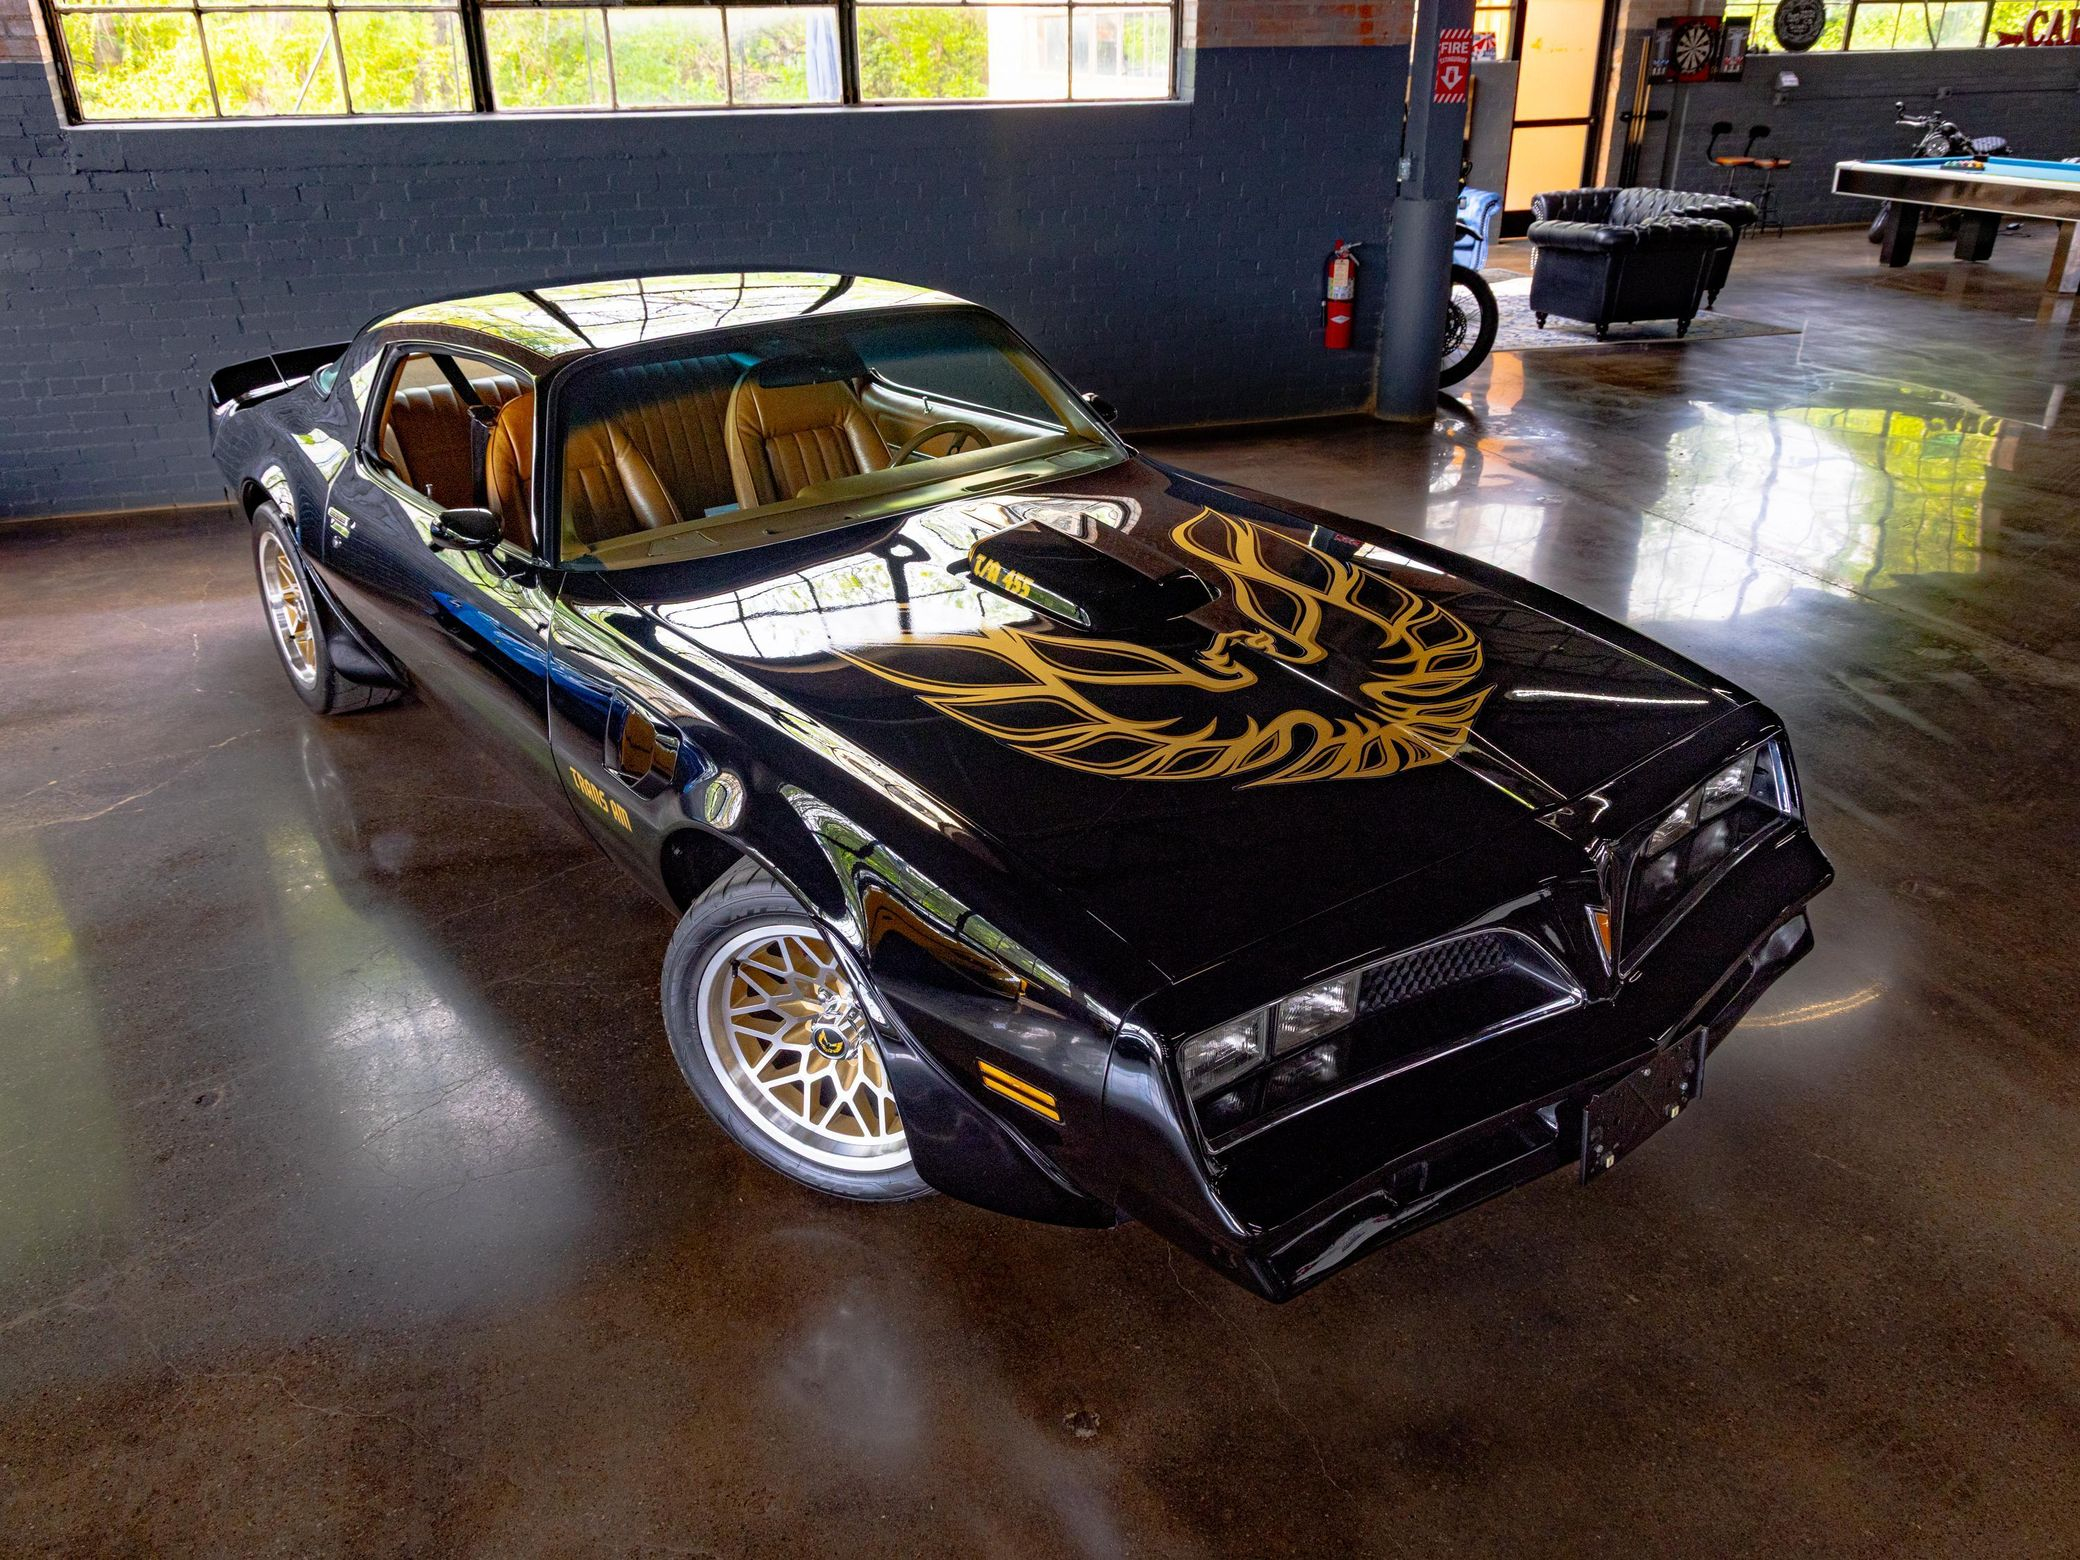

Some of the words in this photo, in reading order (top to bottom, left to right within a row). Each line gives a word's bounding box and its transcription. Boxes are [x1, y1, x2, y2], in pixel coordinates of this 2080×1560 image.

[1440, 41, 1470, 54] FIRE
[973, 553, 1001, 585] T/A
[1001, 569, 1035, 599] 455
